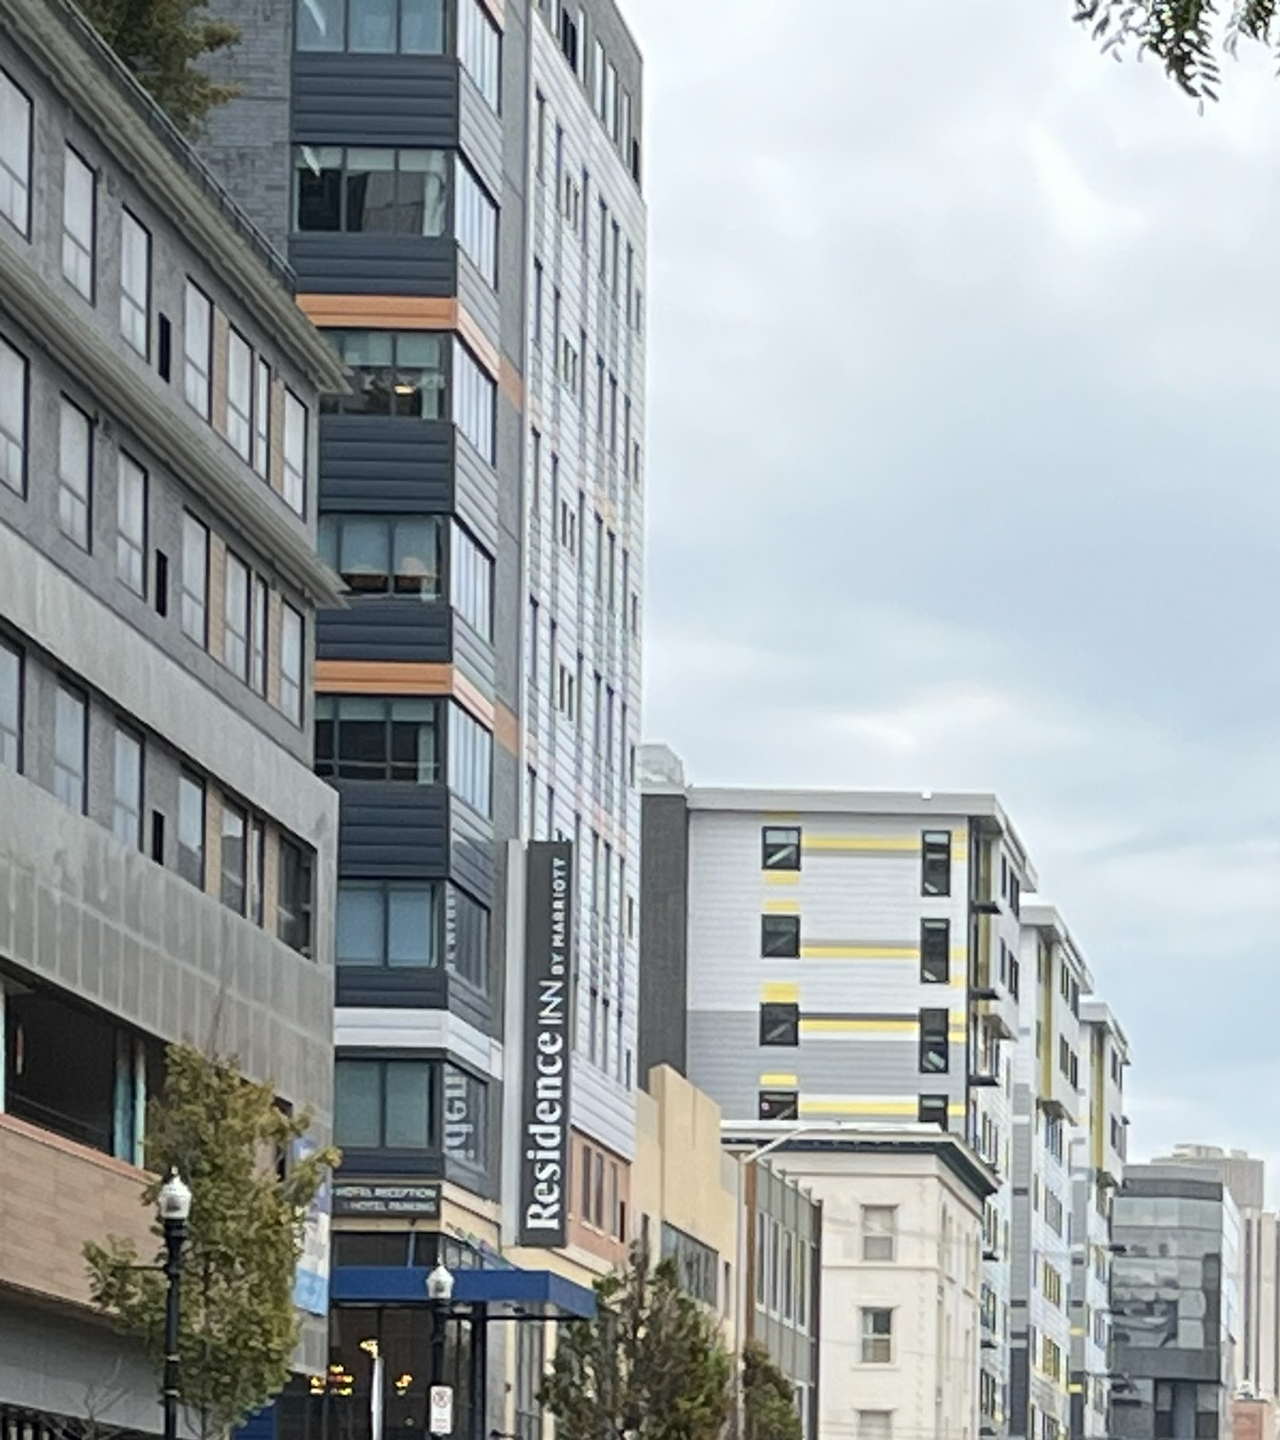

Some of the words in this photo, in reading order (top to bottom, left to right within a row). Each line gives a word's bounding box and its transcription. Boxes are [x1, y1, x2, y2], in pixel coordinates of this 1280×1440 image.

[552, 857, 567, 949] MARRIOTT
[551, 951, 565, 976] BY
[538, 980, 563, 1026] INN
[526, 1030, 564, 1231] Residence
